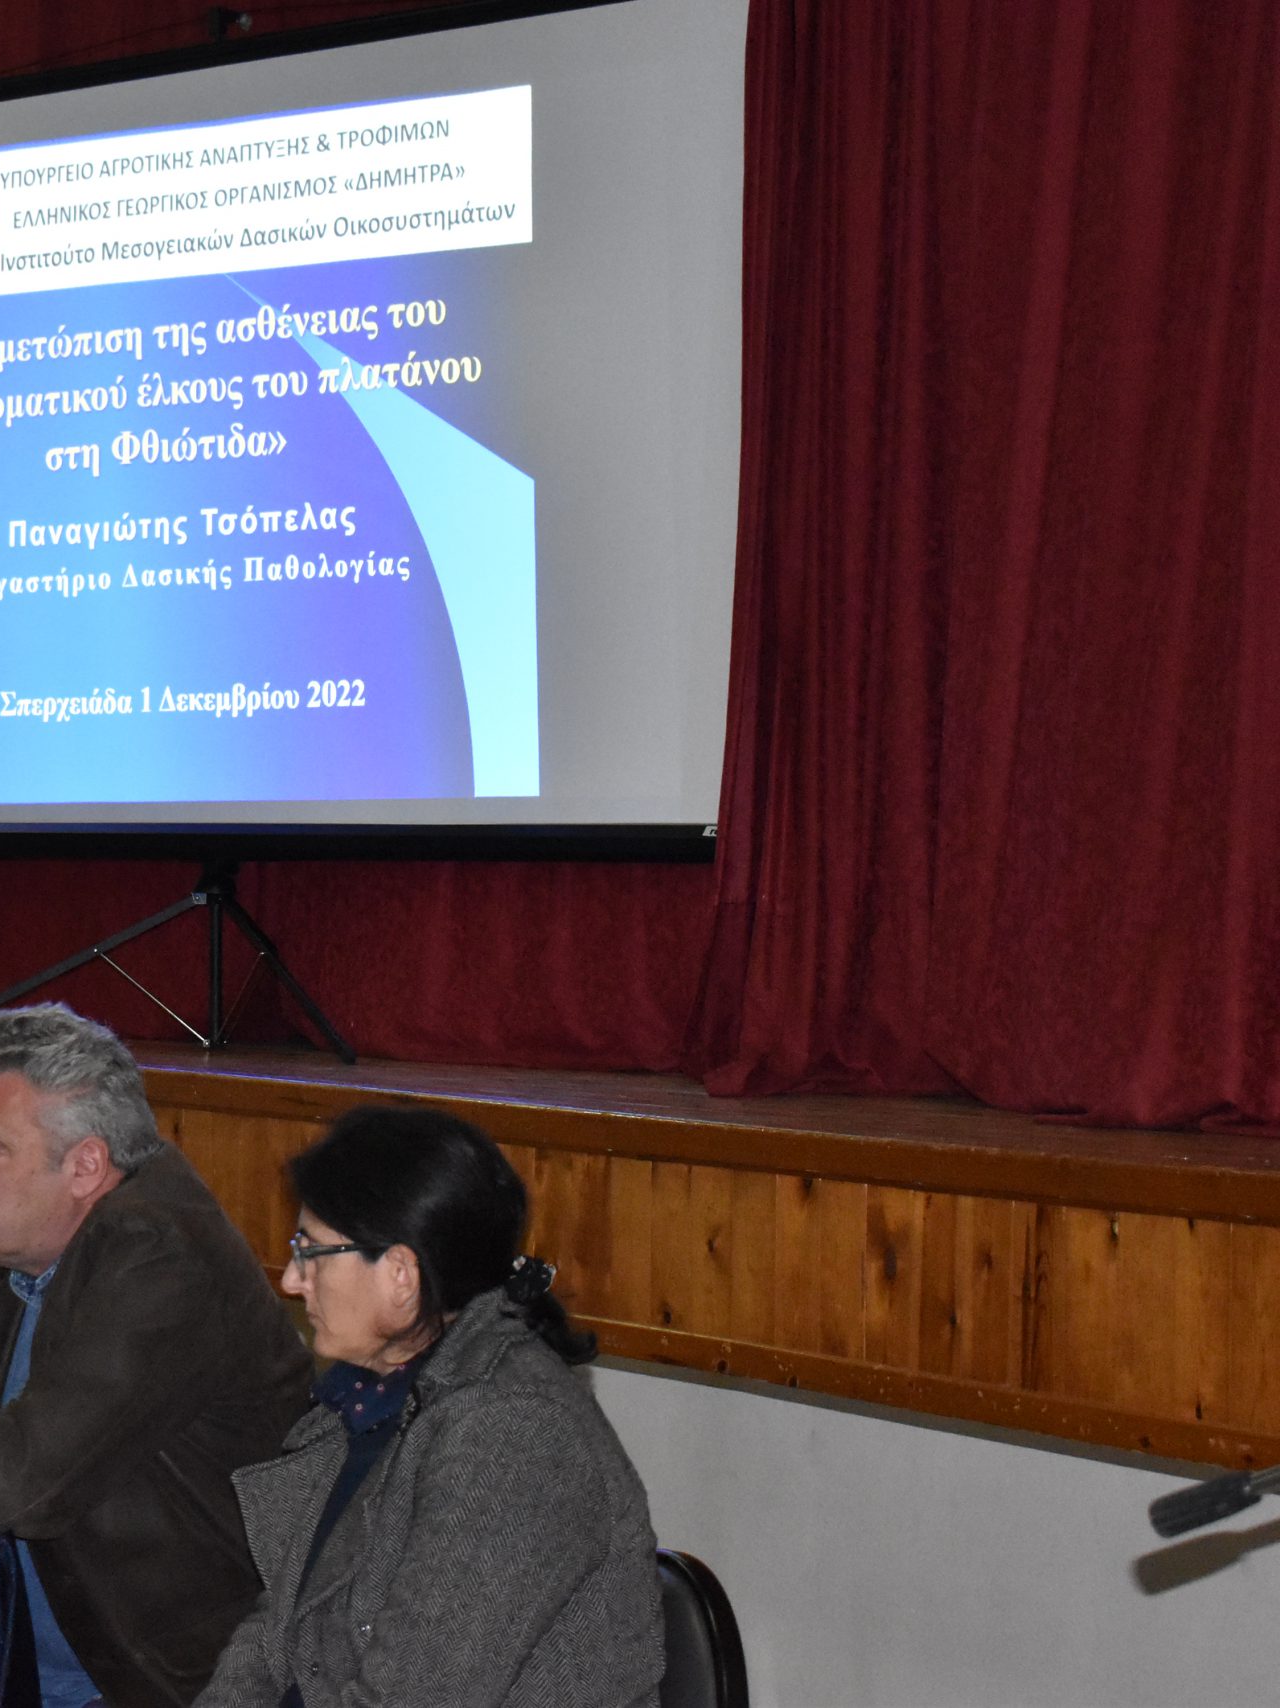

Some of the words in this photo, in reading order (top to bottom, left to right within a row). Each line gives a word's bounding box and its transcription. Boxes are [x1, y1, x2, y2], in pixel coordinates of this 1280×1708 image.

[0, 162, 94, 190] ΥΠΟΥΡΓΕΙΟ
[99, 150, 194, 178] ΑΓΡΟΤΙΚΗΣ
[200, 136, 310, 167] ΑΝΑΠΤΥΞΗΣ
[316, 133, 331, 153] &
[336, 119, 449, 150] ΤΡΟΦΙΜΩΝ
[13, 200, 111, 229] ΕΛΛΗΝΙΚΟΣ
[117, 190, 209, 217] ΓΕΩΡΓΙΚΟΣ
[214, 175, 337, 207] ΟΡΓΑΝΙΣΜΟΣ
[344, 162, 465, 192] «ΔΗΜΗΤΡΑ»
[0, 243, 95, 272] Ινστιτούτο
[101, 228, 234, 261] Μεσογειακών
[239, 218, 327, 248] Δασικών
[333, 200, 516, 238] Οικοσυστημάτων
[153, 321, 207, 357] της
[216, 303, 378, 340] ασθένειας
[387, 299, 447, 329] του
[136, 372, 243, 410] έλκους
[251, 370, 308, 399] του
[318, 351, 482, 394] πλατάνου
[45, 442, 100, 477] στη
[111, 422, 287, 465] Φθιώτιδα»
[8, 513, 188, 549] Παναγιώτης
[200, 502, 356, 536] Τσόπελας
[122, 560, 232, 589] Δασικής
[243, 551, 411, 583] Παθολογίας
[0, 688, 132, 722] Σπερχειάδα
[140, 686, 152, 714] 1
[159, 682, 300, 718] Δεκεμβρίου
[306, 679, 366, 708] 2022
